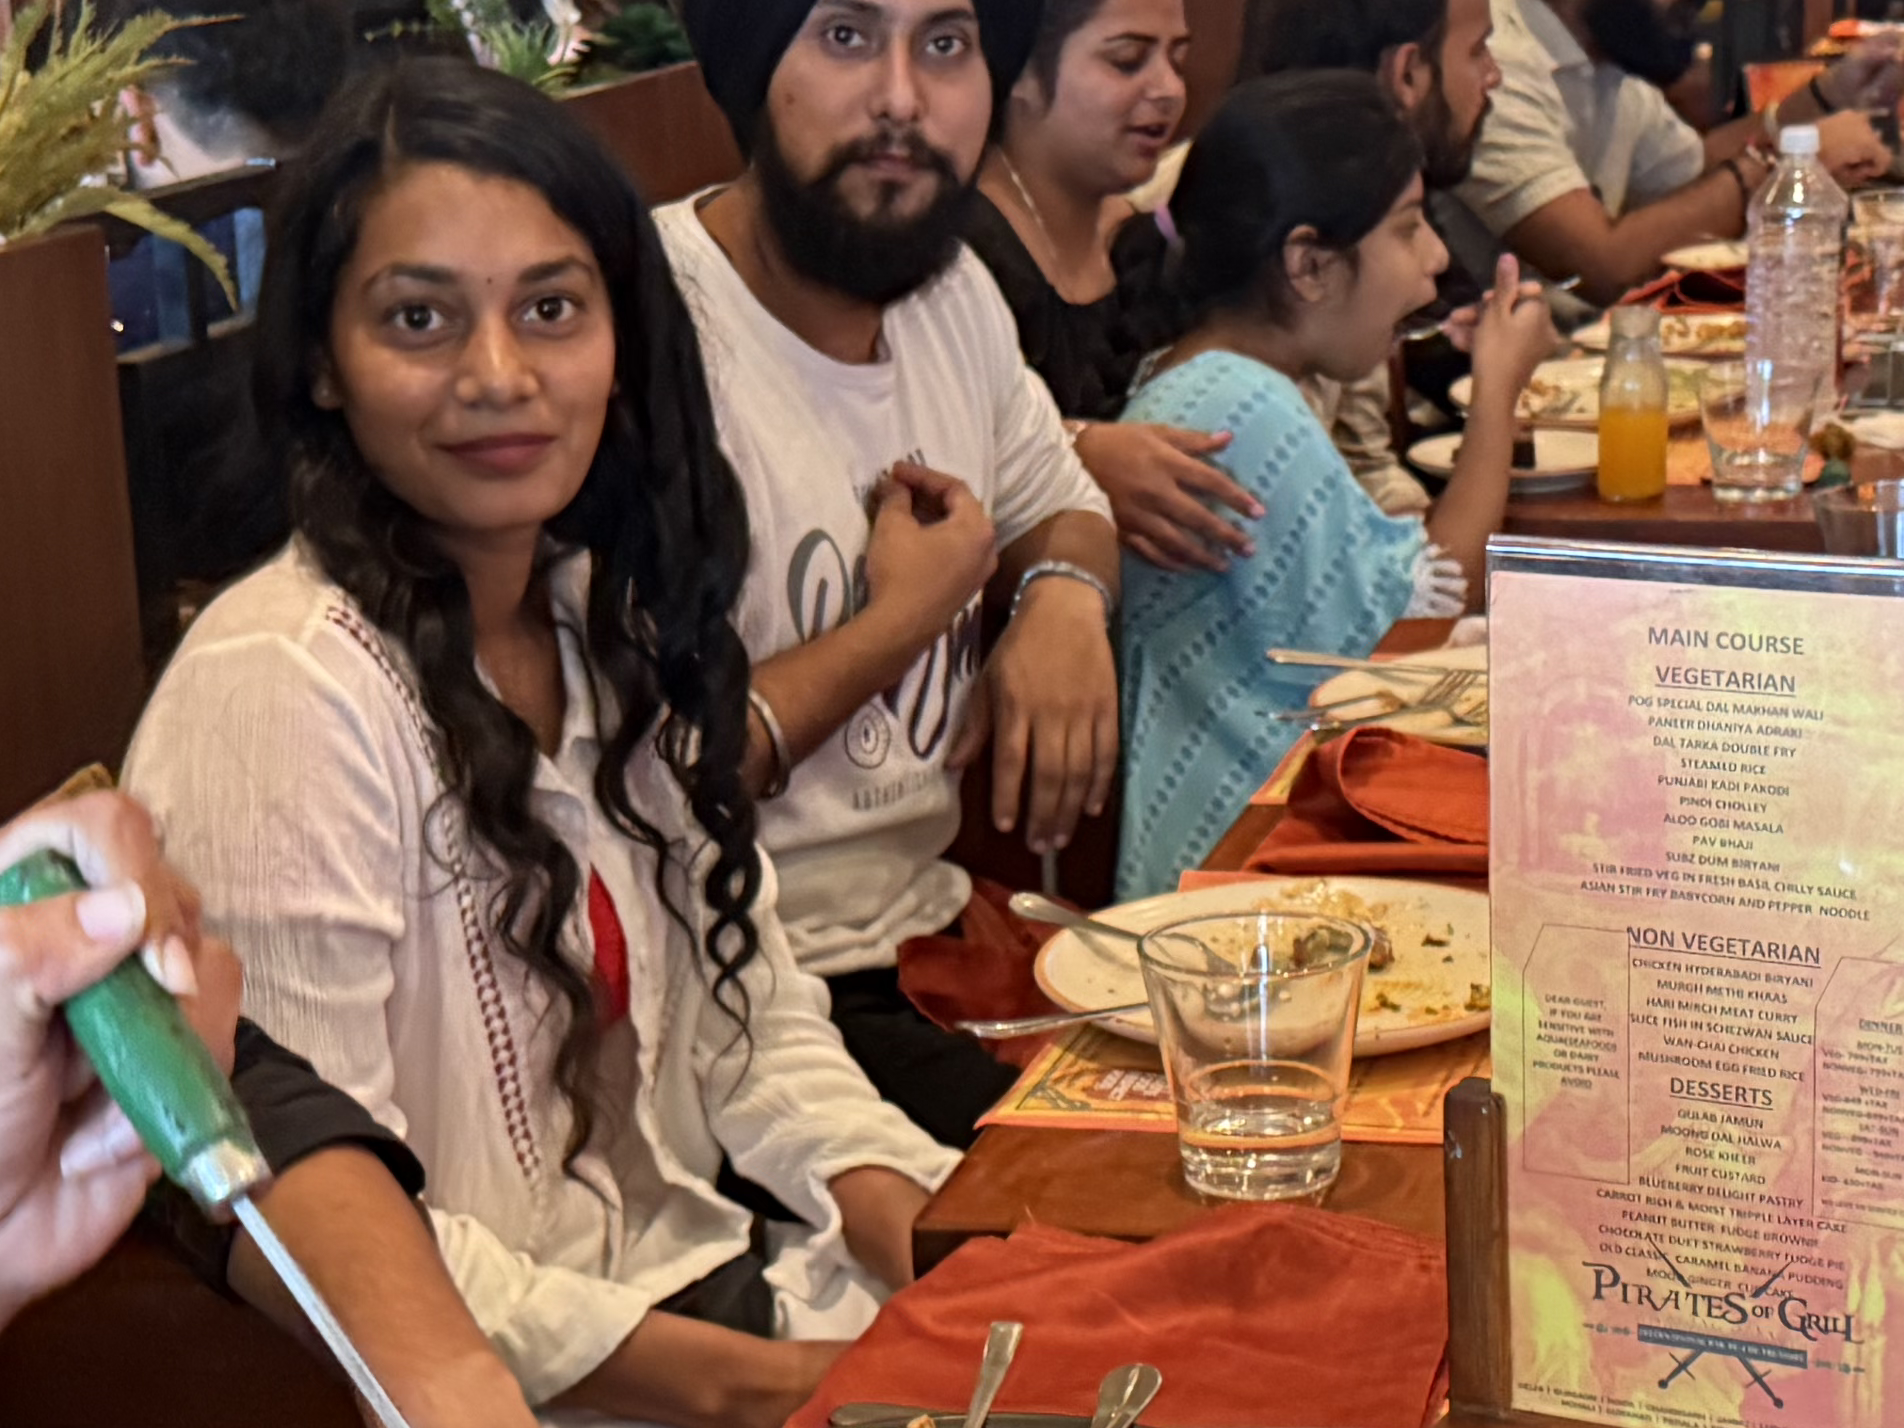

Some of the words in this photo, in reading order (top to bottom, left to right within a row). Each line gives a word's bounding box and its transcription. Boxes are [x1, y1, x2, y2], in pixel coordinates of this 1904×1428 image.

[1648, 627, 1708, 648] MAIN
[1716, 632, 1805, 655] COURSE
[1655, 665, 1796, 695] VEGETARIAN
[1657, 697, 1703, 712] SPECIAL
[1706, 700, 1729, 714] DAL
[1732, 703, 1789, 718] MAKHAN
[1648, 716, 1695, 730] PANEER
[1697, 719, 1753, 735] DHANIYA
[1653, 736, 1676, 749] DAL
[1679, 737, 1718, 752] TARKA
[1721, 741, 1769, 756] DOUBLE
[1773, 745, 1796, 759] FRY
[1681, 758, 1737, 773] STEAMED
[1740, 763, 1766, 775] RICE
[1657, 775, 1708, 790] PUNJABI
[1711, 779, 1740, 792] KADI
[1679, 796, 1712, 809] PINDI
[1715, 799, 1767, 814] CHOLLEY
[1663, 813, 1697, 826] ALOO
[1699, 816, 1730, 830] GOBI
[1733, 819, 1784, 834] MASALA
[1692, 835, 1716, 848] PAV
[1719, 837, 1754, 850] BHAJI
[1665, 851, 1696, 865] SUBZ
[1698, 855, 1728, 868] DUM
[1731, 858, 1780, 873] BIRYANI
[1593, 862, 1617, 875] STIR
[1620, 865, 1653, 879] FRIED
[1655, 869, 1679, 882] VEG
[1682, 871, 1696, 883] IN
[1698, 873, 1735, 887] FRESH
[1738, 878, 1771, 892] BASIL
[1816, 885, 1857, 900] SAUCE
[1580, 880, 1615, 894] ASIAN
[1618, 883, 1642, 896] STIR
[1646, 887, 1667, 899] FRY
[1669, 889, 1735, 906] BABYCORN
[1738, 896, 1766, 910] AND
[1768, 900, 1813, 915] PEPPER
[1819, 905, 1870, 921] NOODLE
[1627, 926, 1675, 948] NON
[1681, 932, 1821, 965] VEGETARIAN
[1632, 958, 1682, 974] CHICKEN
[1685, 963, 1761, 982] HYDERABADI
[1765, 973, 1813, 988] BIRYANI
[1657, 979, 1703, 994] MURGH
[1706, 984, 1744, 999] METHI
[1646, 997, 1675, 1010] HARI
[1678, 1001, 1717, 1016] MIRCH
[1719, 1006, 1754, 1020] MEAT
[1758, 1010, 1798, 1024] CURRY
[1631, 1013, 1658, 1027] SLICE
[1663, 1017, 1688, 1030] FISH
[1690, 1019, 1703, 1032] IN
[1706, 1021, 1772, 1041] SCHEZWAN
[1776, 1031, 1812, 1046] SAUCE
[1728, 1044, 1780, 1060] CHICKEN
[1638, 1052, 1712, 1070] MUSHROOM
[1715, 1060, 1740, 1073] EGG
[1743, 1064, 1777, 1078] FRIED
[1780, 1068, 1805, 1082] RICE
[1670, 1077, 1773, 1106] DESSERTS
[1678, 1109, 1717, 1124] GULAB
[1720, 1114, 1764, 1129] JAMUN
[1661, 1125, 1708, 1140] MOONG
[1711, 1131, 1733, 1144] DAL
[1737, 1135, 1782, 1150] HALWA
[1686, 1147, 1714, 1160] ROSE
[1718, 1151, 1756, 1165] KHEER
[1676, 1164, 1707, 1178] FRUIT
[1711, 1168, 1766, 1185] CUSTARD
[1639, 1176, 1703, 1194] BLUEBERRY
[1707, 1186, 1755, 1203] DELIGHT
[1759, 1194, 1804, 1209] PASTRY
[1597, 1189, 1641, 1204] CARROT
[1646, 1195, 1672, 1208] RICH
[1688, 1202, 1726, 1217] MOIST
[1777, 1214, 1814, 1229] LAYER
[1817, 1221, 1846, 1234] CAKE
[1622, 1210, 1667, 1226] PEANUT
[1670, 1217, 1715, 1232] BUTTER
[1721, 1225, 1759, 1240] FUDGE
[1763, 1231, 1819, 1248] BROWNIE
[1598, 1224, 1665, 1244] CHOCOLATE
[1668, 1235, 1699, 1249] DUET
[1701, 1239, 1786, 1261] STRAWBERRY
[1784, 1253, 1824, 1269] FUDGE
[1827, 1258, 1845, 1271] PIE
[1600, 1242, 1622, 1255] OLD
[1676, 1255, 1731, 1272] CARAMEL
[1788, 1272, 1844, 1290] PUDDING
[1688, 1275, 1732, 1290] GINGER
[1582, 1261, 1749, 1325] PIRATES
[1751, 1305, 1774, 1320] OF
[1777, 1298, 1864, 1344] GRILL
